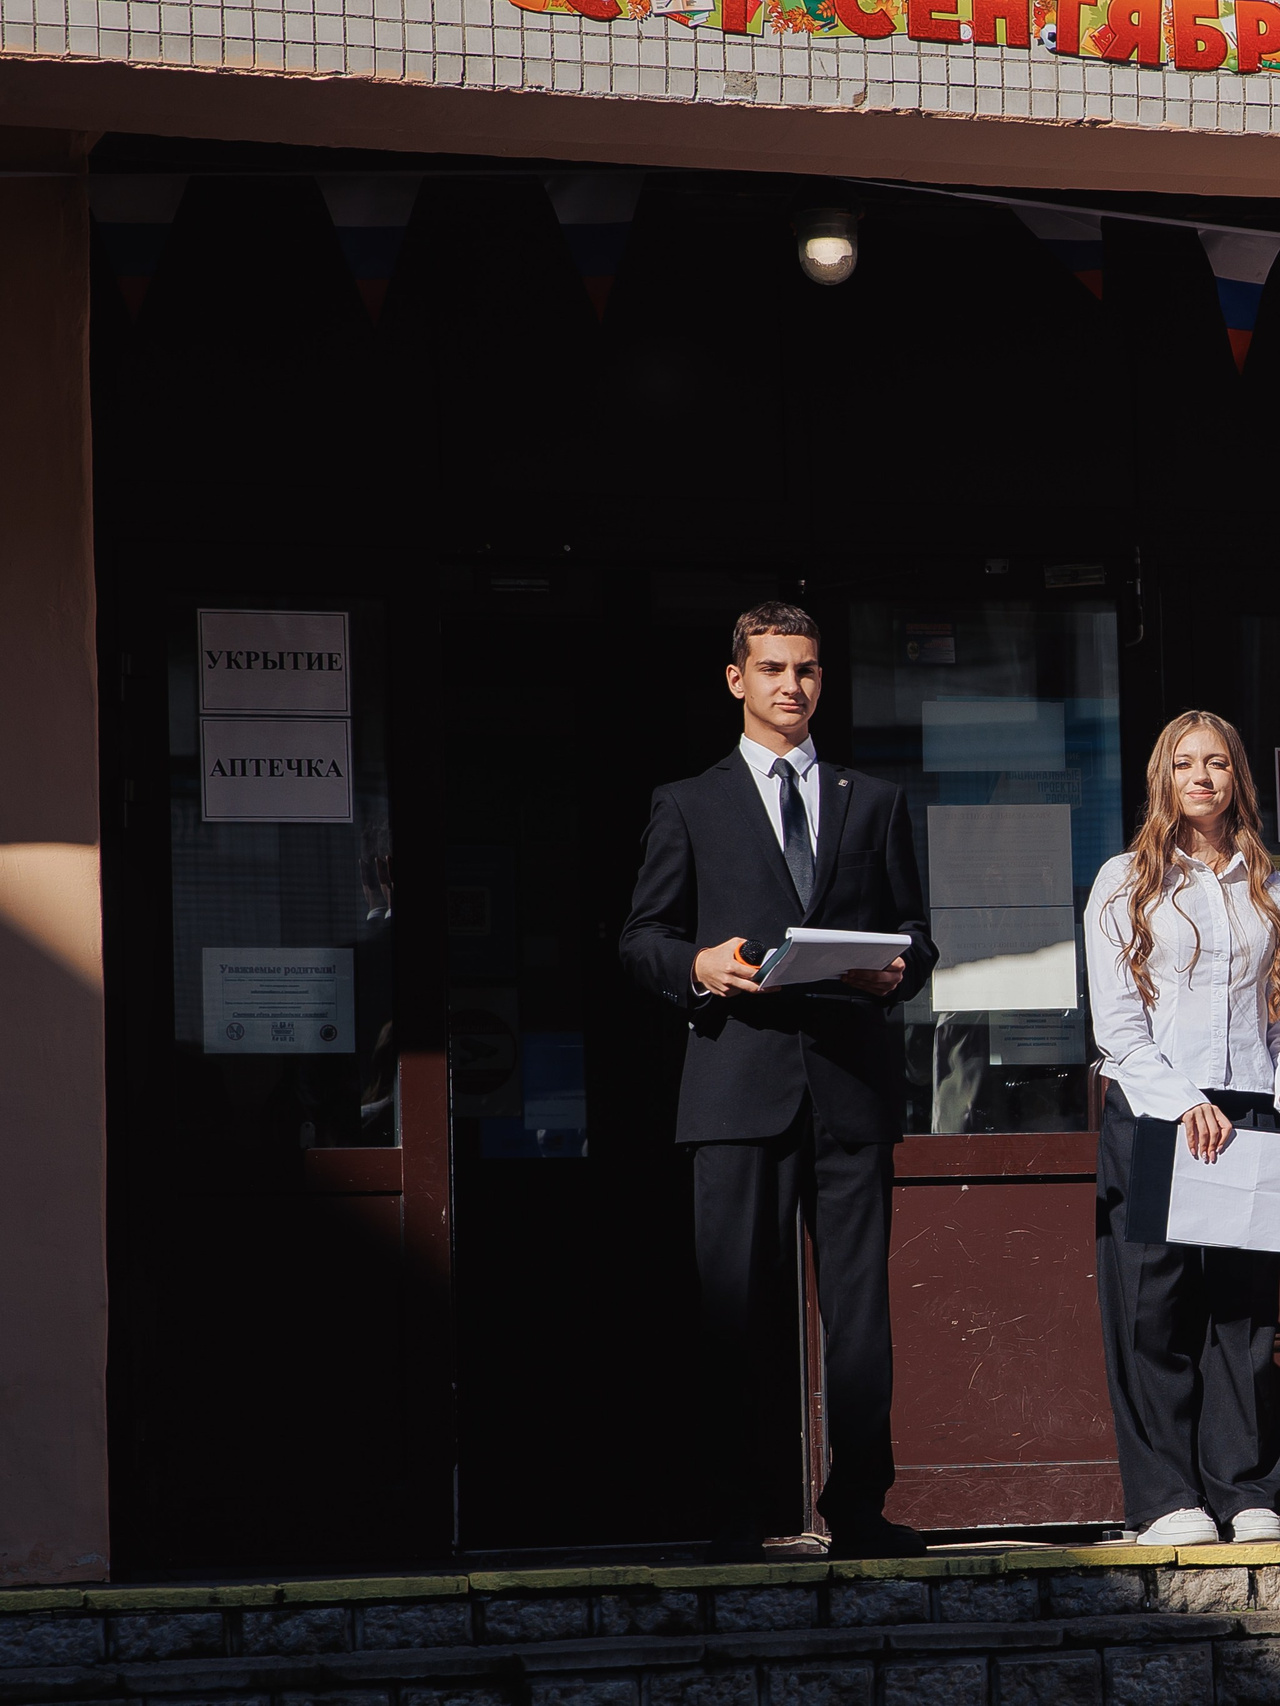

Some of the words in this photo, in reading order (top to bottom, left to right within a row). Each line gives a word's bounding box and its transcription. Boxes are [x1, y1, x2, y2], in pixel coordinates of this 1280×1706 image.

[205, 650, 343, 671] УКРЫТИЕ
[209, 758, 344, 777] АПТЕЧКА
[1037, 781, 1081, 793] ПРОЕКТЫ
[1046, 793, 1081, 804] РОССИИ
[219, 964, 281, 974] Уважаемые
[284, 964, 336, 976] родители!
